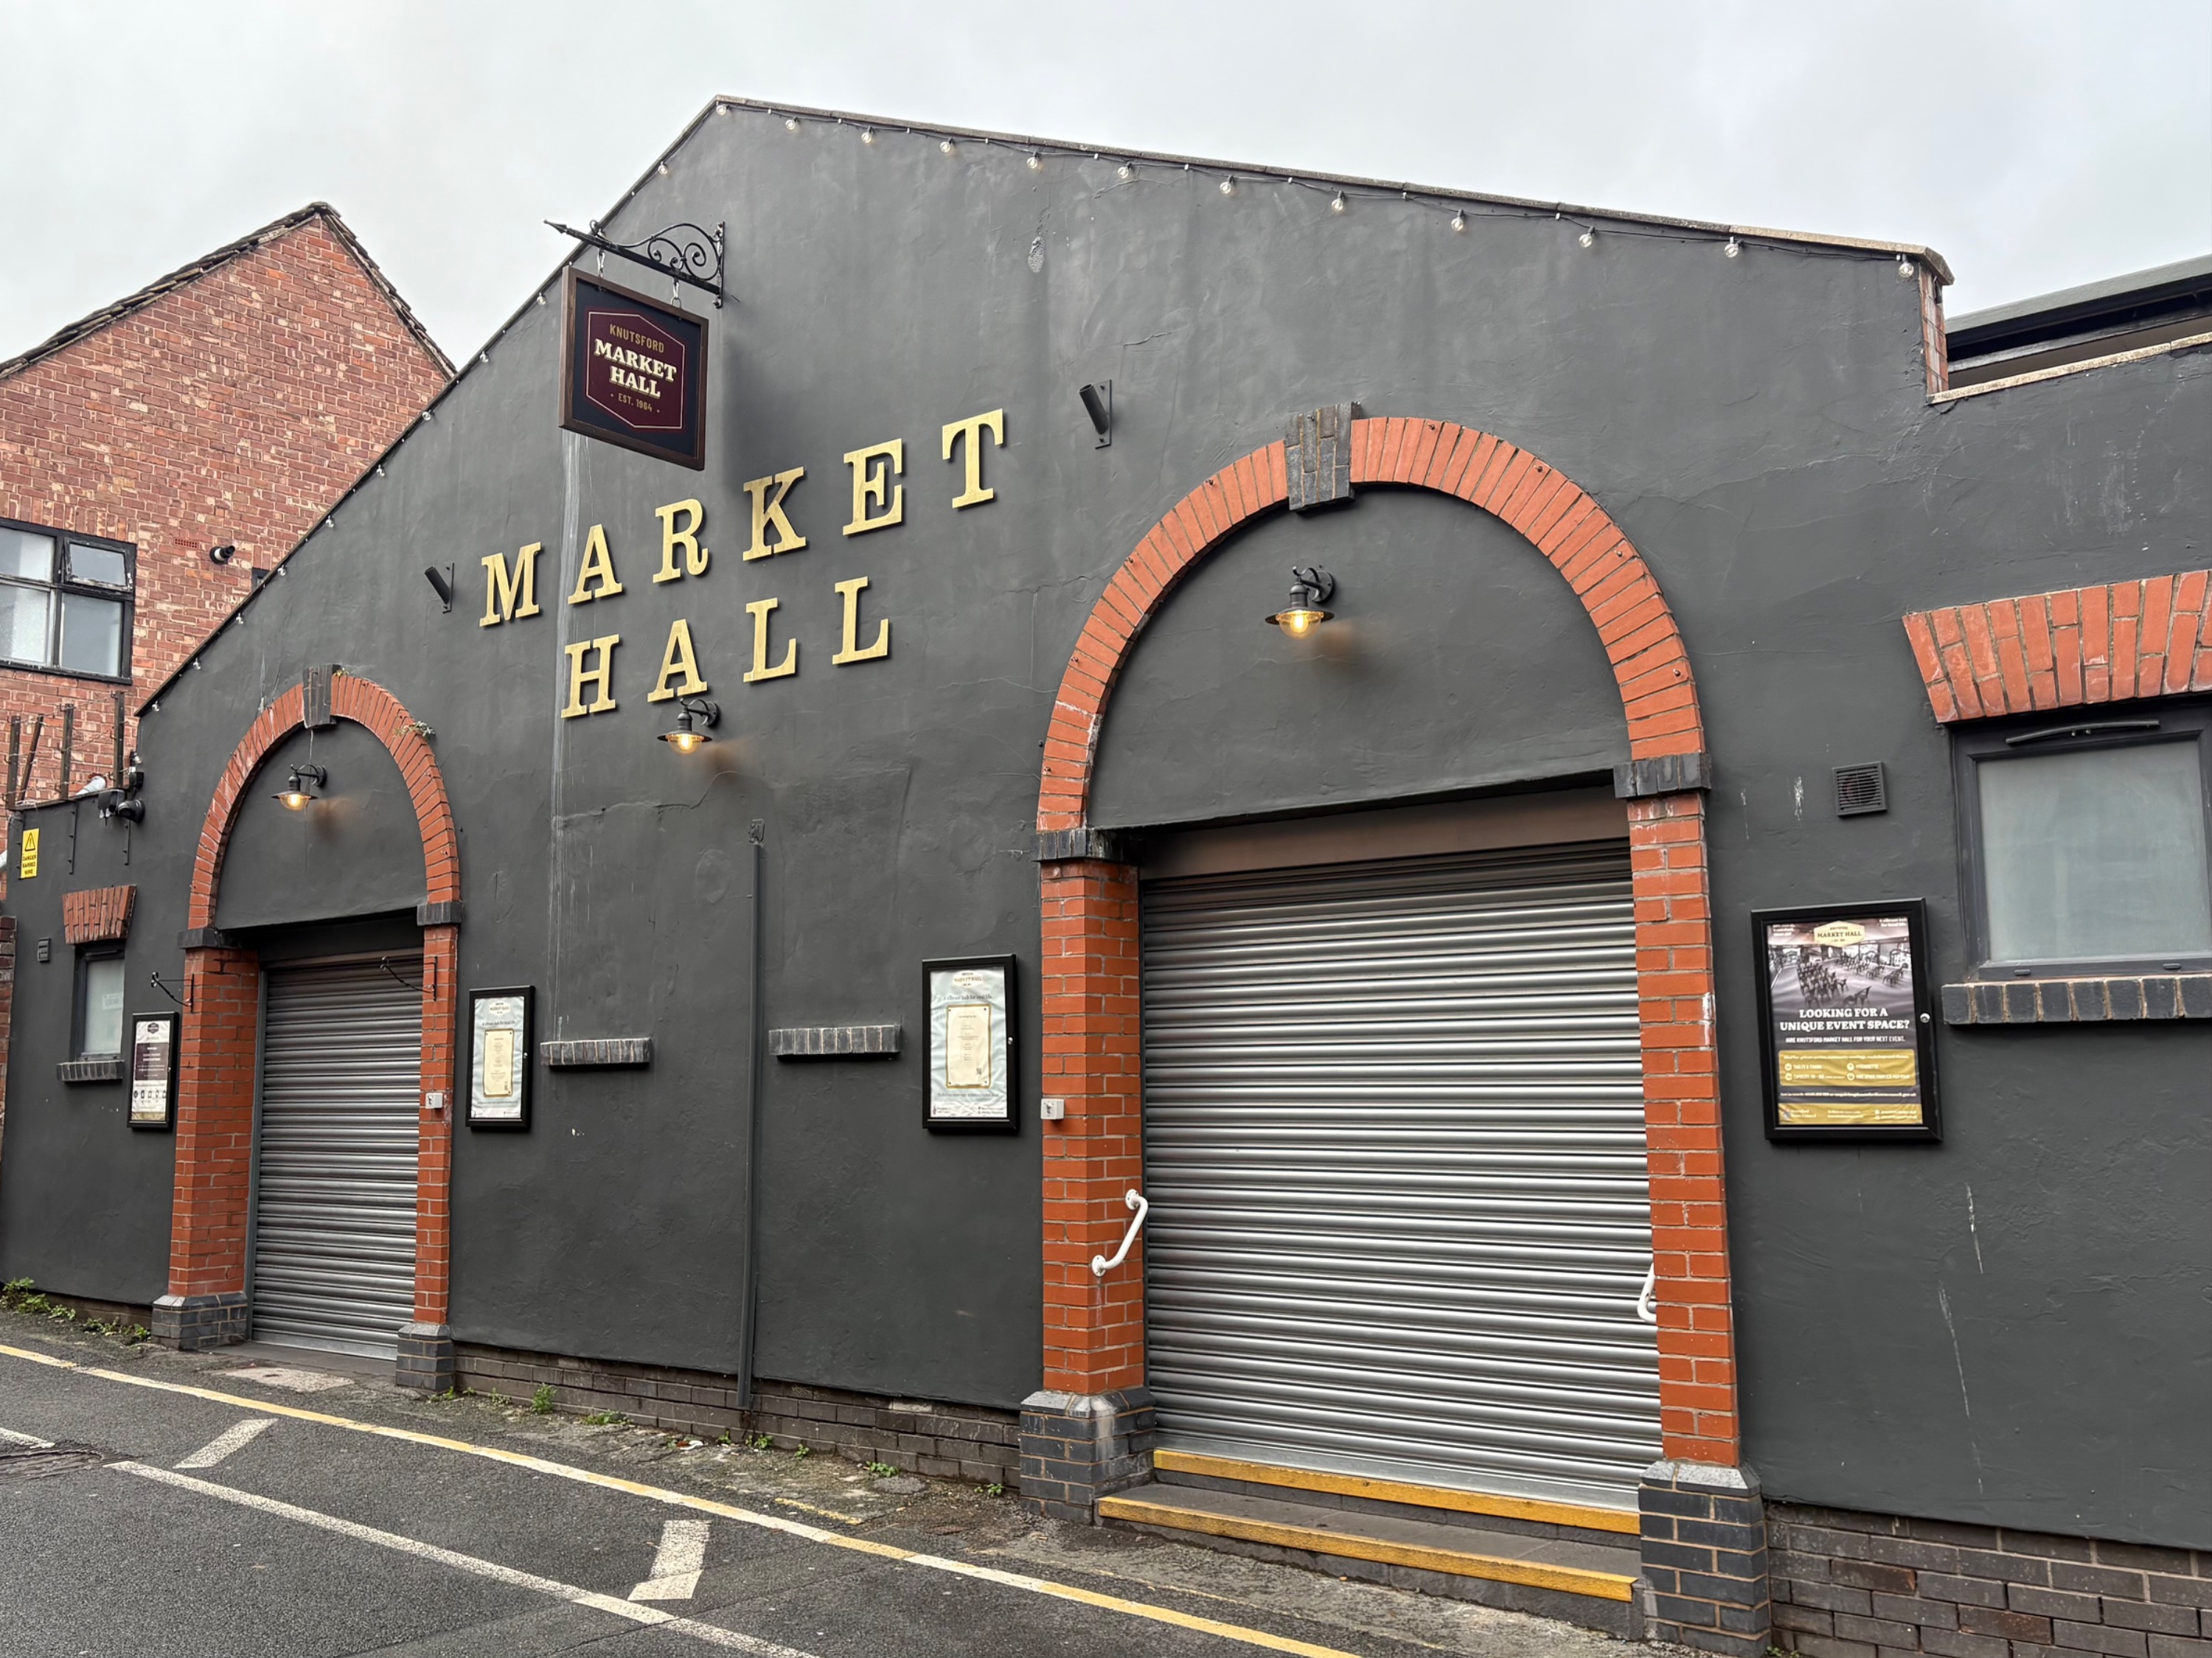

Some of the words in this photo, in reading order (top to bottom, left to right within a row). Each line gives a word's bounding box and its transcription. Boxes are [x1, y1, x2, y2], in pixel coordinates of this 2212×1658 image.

[610, 324, 664, 354] KNUTSFORD
[594, 338, 676, 382] MARKET
[609, 366, 661, 400] HALL
[618, 392, 634, 405] EST.
[479, 408, 1004, 627] MARKET
[560, 576, 890, 719] HALL
[1779, 1021, 1824, 1032] UNIQUE
[1826, 1020, 1865, 1030] EVENT
[1867, 1020, 1910, 1030] SPACE?
[1799, 1008, 1852, 1018] LOOKING
[1854, 1008, 1877, 1017] FOR
[1879, 1007, 1888, 1017] A
